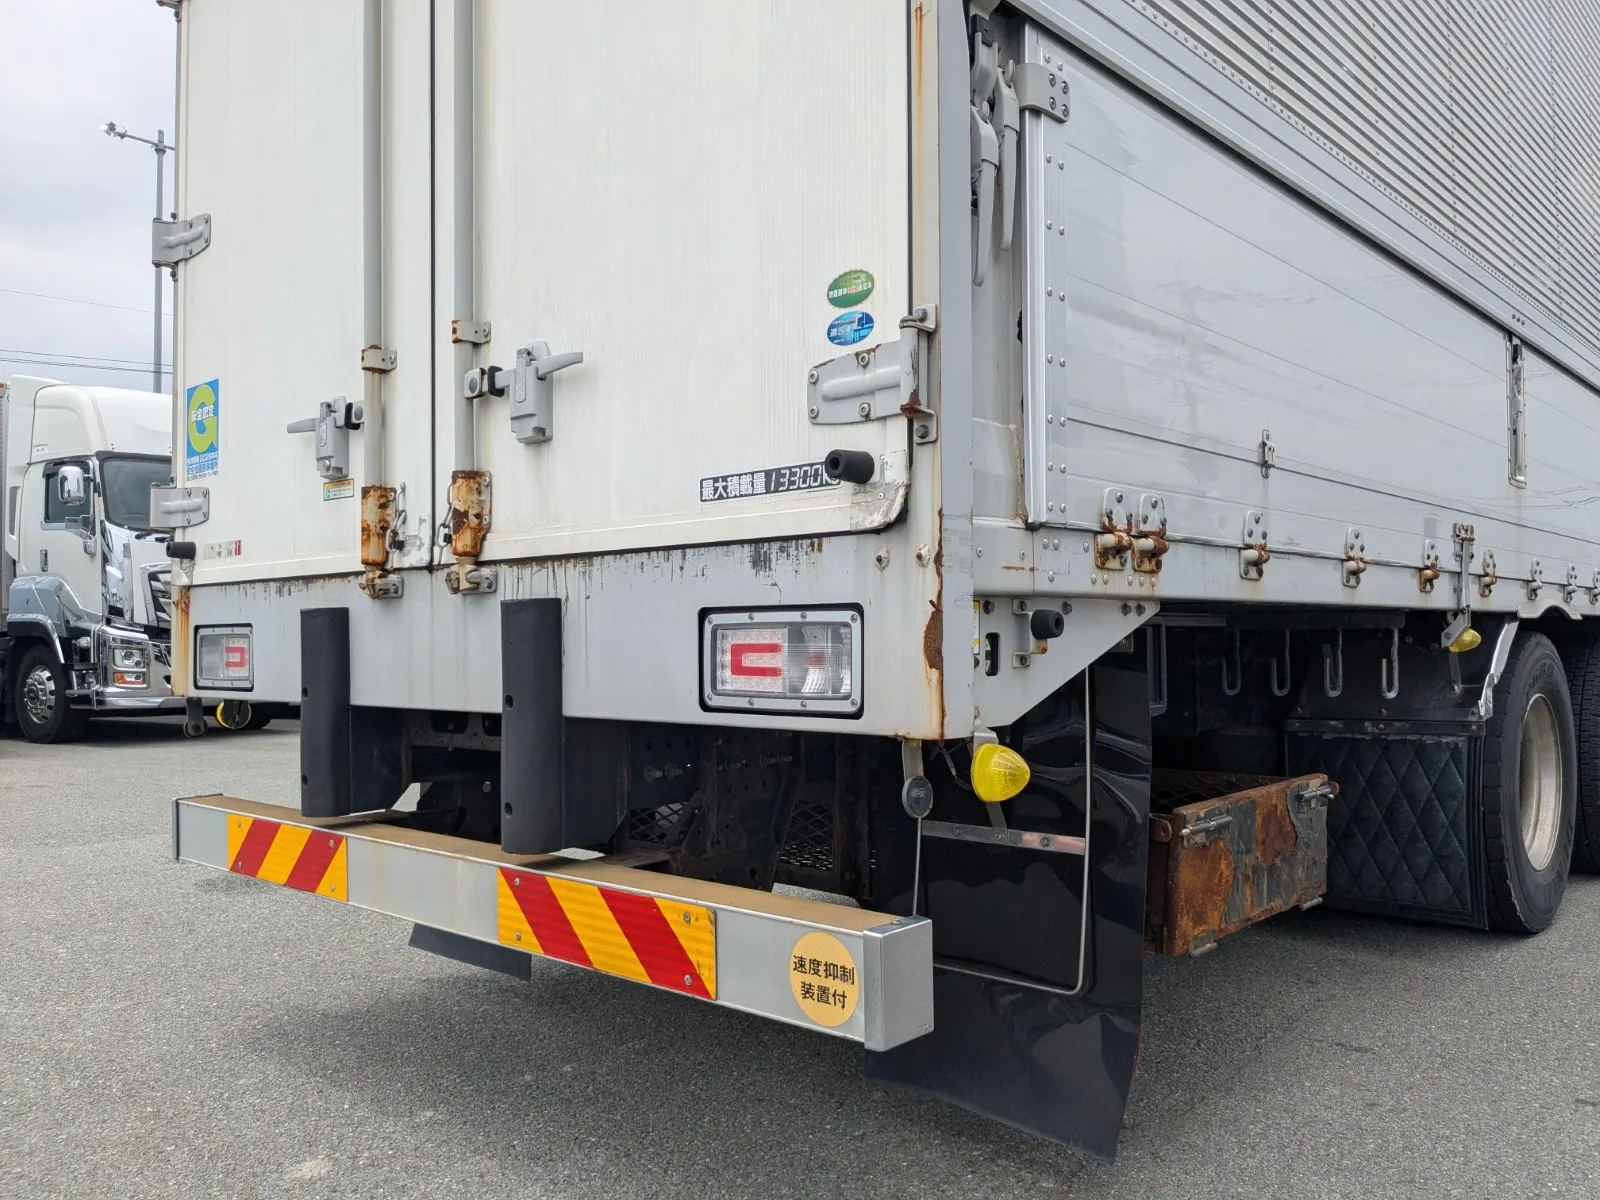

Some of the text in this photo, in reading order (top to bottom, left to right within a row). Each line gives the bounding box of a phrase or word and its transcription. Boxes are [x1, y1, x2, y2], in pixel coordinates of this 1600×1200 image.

[701, 472, 767, 501] 最大積載量
[792, 954, 855, 986] 速度抑制
[800, 980, 848, 1010] 装置付
